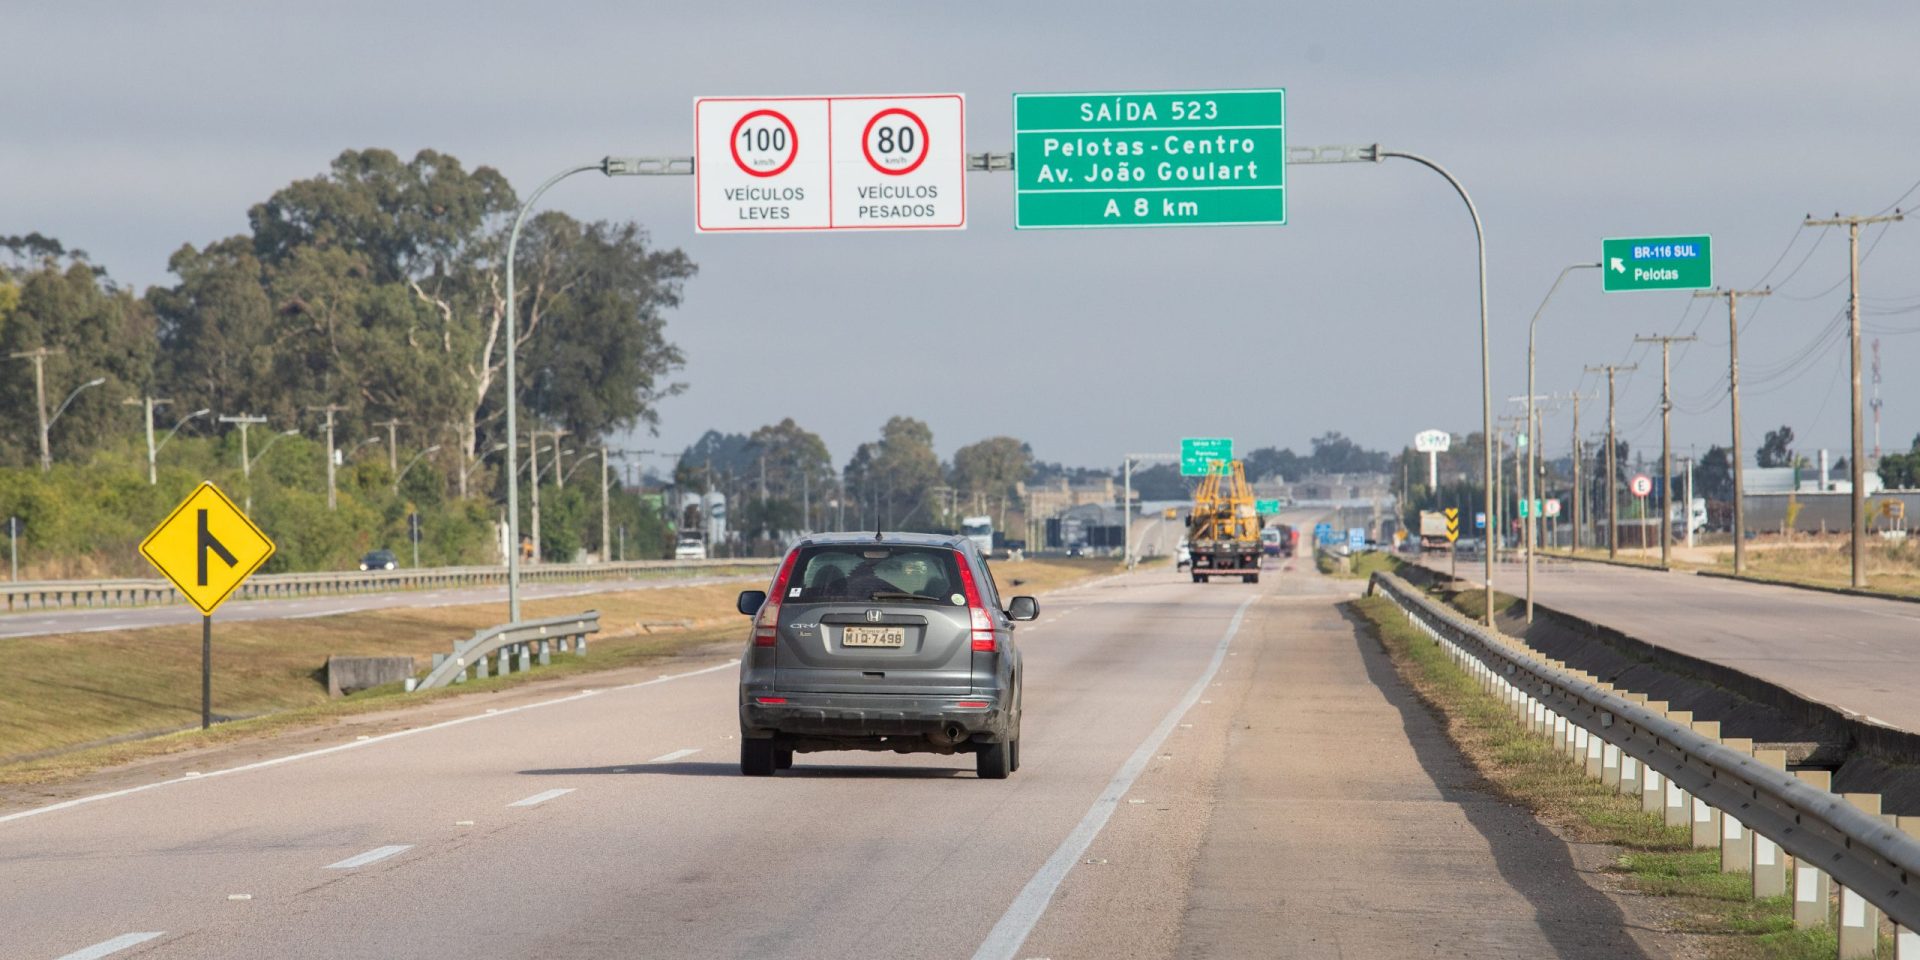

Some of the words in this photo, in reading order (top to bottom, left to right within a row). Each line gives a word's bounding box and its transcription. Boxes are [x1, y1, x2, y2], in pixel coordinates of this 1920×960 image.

[1080, 97, 1158, 122] SAÍDA
[1171, 101, 1219, 121] 523
[741, 127, 787, 153] 100
[877, 126, 915, 154] 80
[753, 158, 776, 168] km/h
[884, 156, 908, 167] km/h
[1037, 164, 1074, 183] Av.
[1083, 161, 1146, 183] João
[1157, 161, 1258, 181] Goulart
[724, 184, 805, 202] VEÍCULOS
[857, 183, 938, 200] VEÍCULOS
[738, 206, 791, 220] LEVES
[858, 203, 936, 219] PESADOS
[1103, 199, 1121, 218] A
[1133, 198, 1149, 217] 8
[1162, 197, 1199, 217] km
[1634, 245, 1672, 259] BR-116
[1673, 244, 1697, 258] SUL
[1634, 267, 1679, 281] Pelotas
